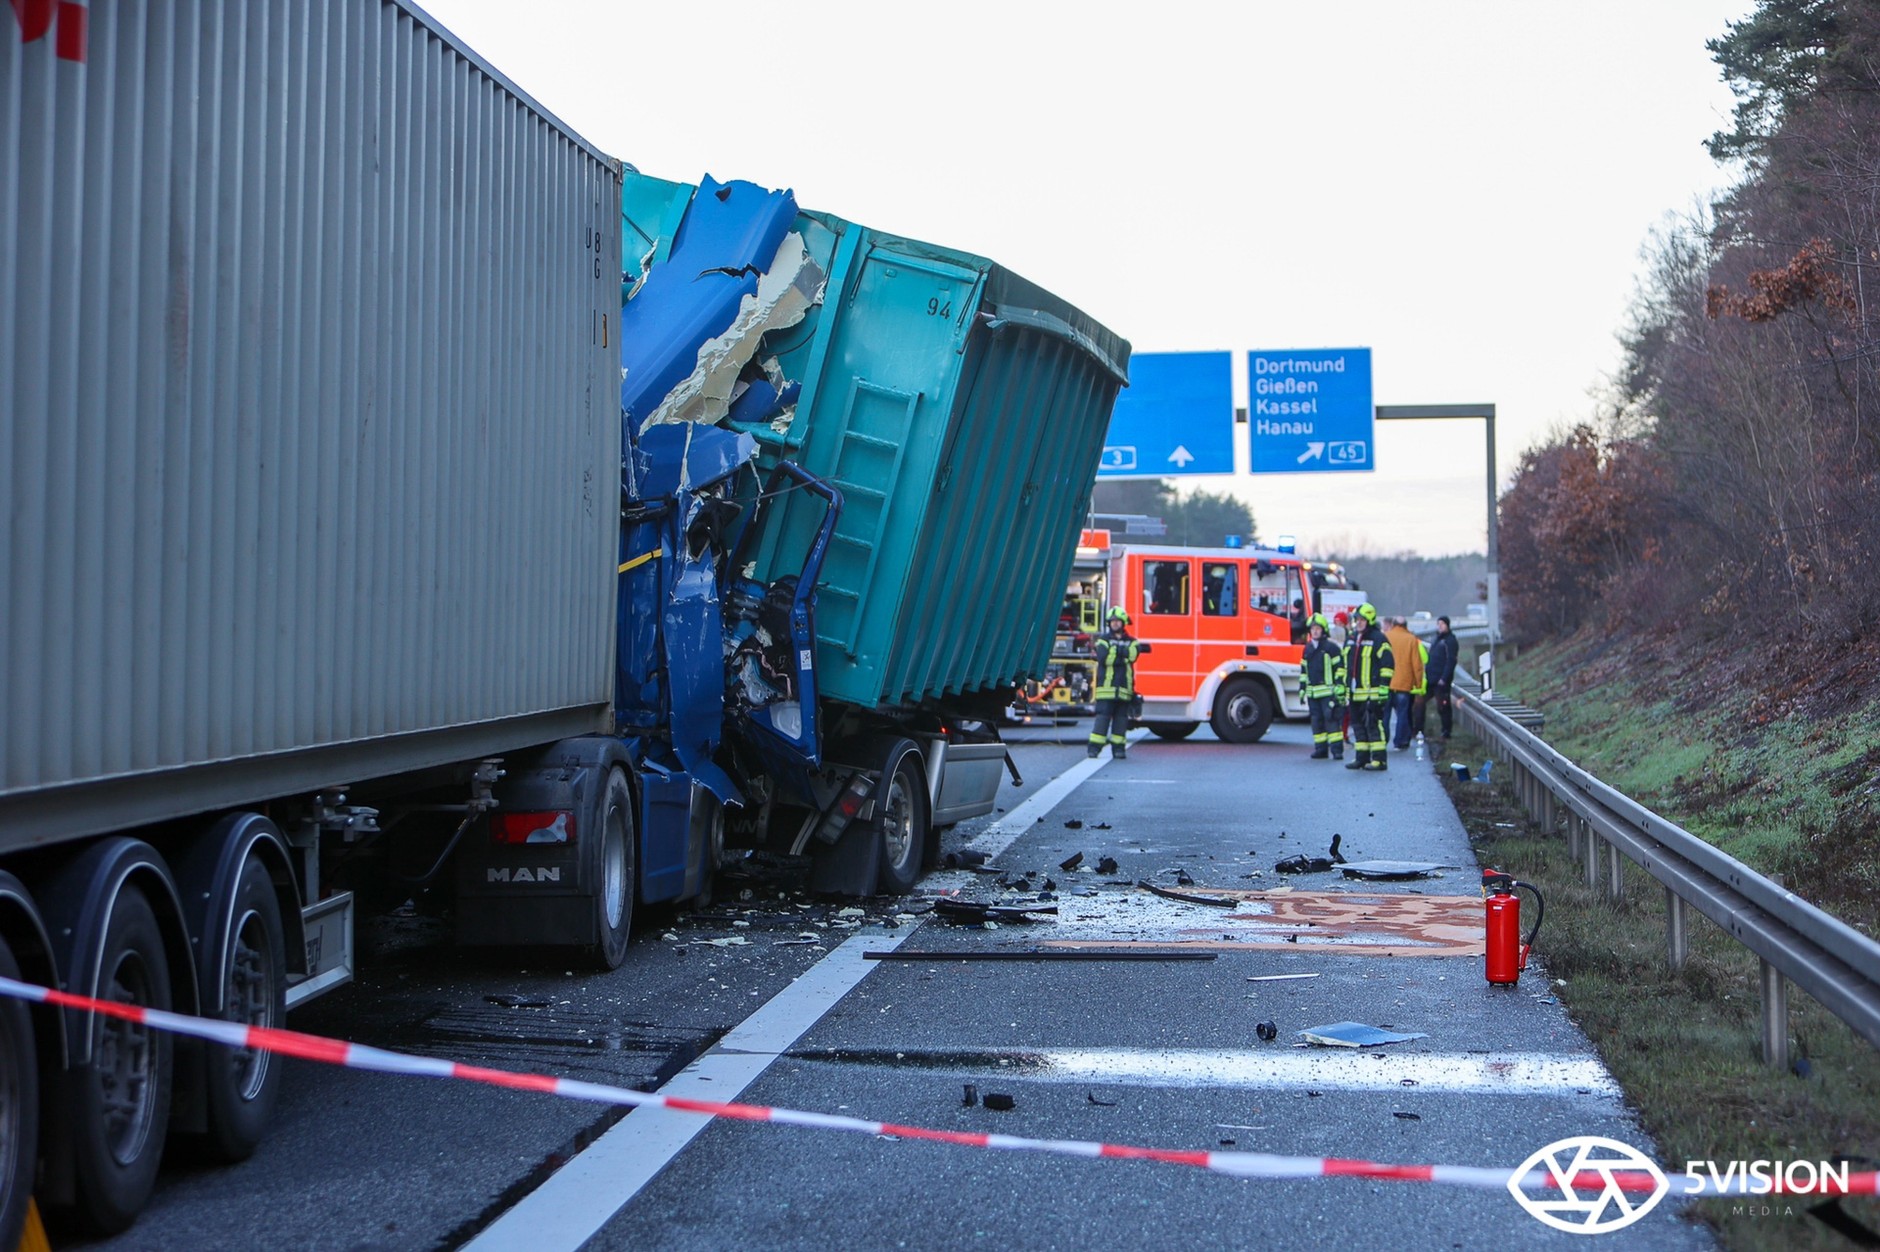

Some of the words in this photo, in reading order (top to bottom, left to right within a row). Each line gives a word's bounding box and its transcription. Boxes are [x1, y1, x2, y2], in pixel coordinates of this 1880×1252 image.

[927, 297, 951, 320] 94
[1255, 356, 1345, 375] Dortmund
[1256, 377, 1318, 395] Gießen
[1256, 398, 1317, 415] Kassel
[1257, 419, 1313, 435] Hanau
[1113, 450, 1122, 465] 3
[1338, 445, 1357, 460] 45
[487, 867, 560, 882] MAN
